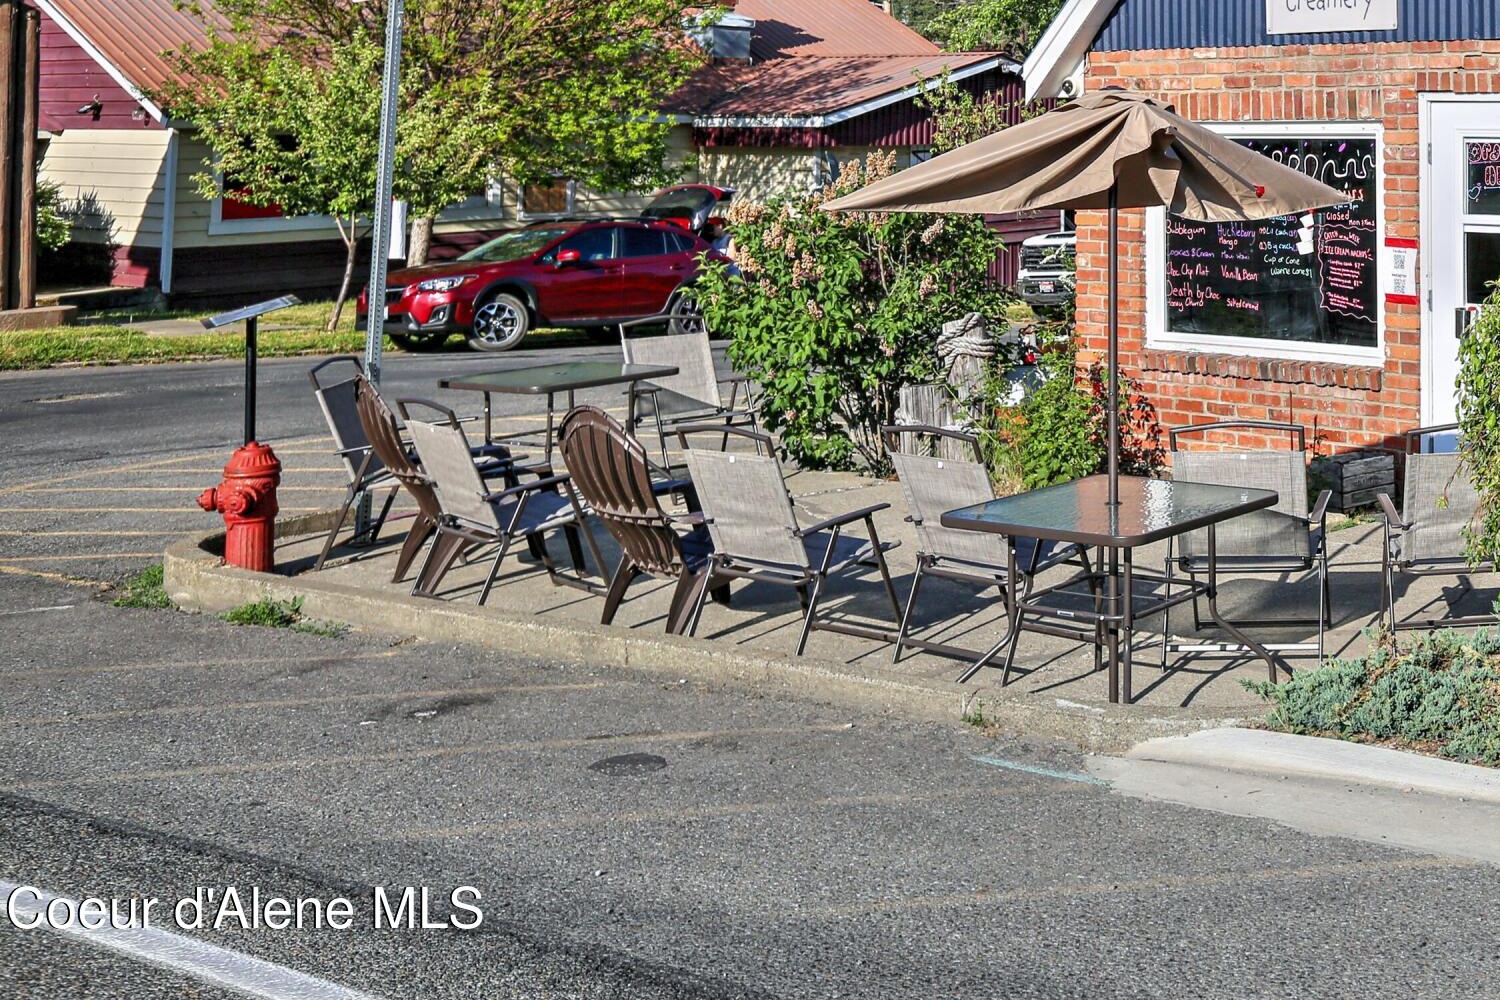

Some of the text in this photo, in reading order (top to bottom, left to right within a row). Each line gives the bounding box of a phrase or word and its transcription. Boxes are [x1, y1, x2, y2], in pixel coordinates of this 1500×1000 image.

[1326, 210, 1349, 221] Closed
[1166, 219, 1206, 240] Bubblegum
[1217, 222, 1256, 246] Huckleberry
[1219, 237, 1238, 250] Mango
[1335, 246, 1349, 255] CREAM
[1264, 254, 1276, 265] Cup
[1285, 256, 1300, 266] Cone
[1242, 268, 1258, 281] Bean
[1167, 280, 1193, 298] Death
[1197, 283, 1205, 299] by
